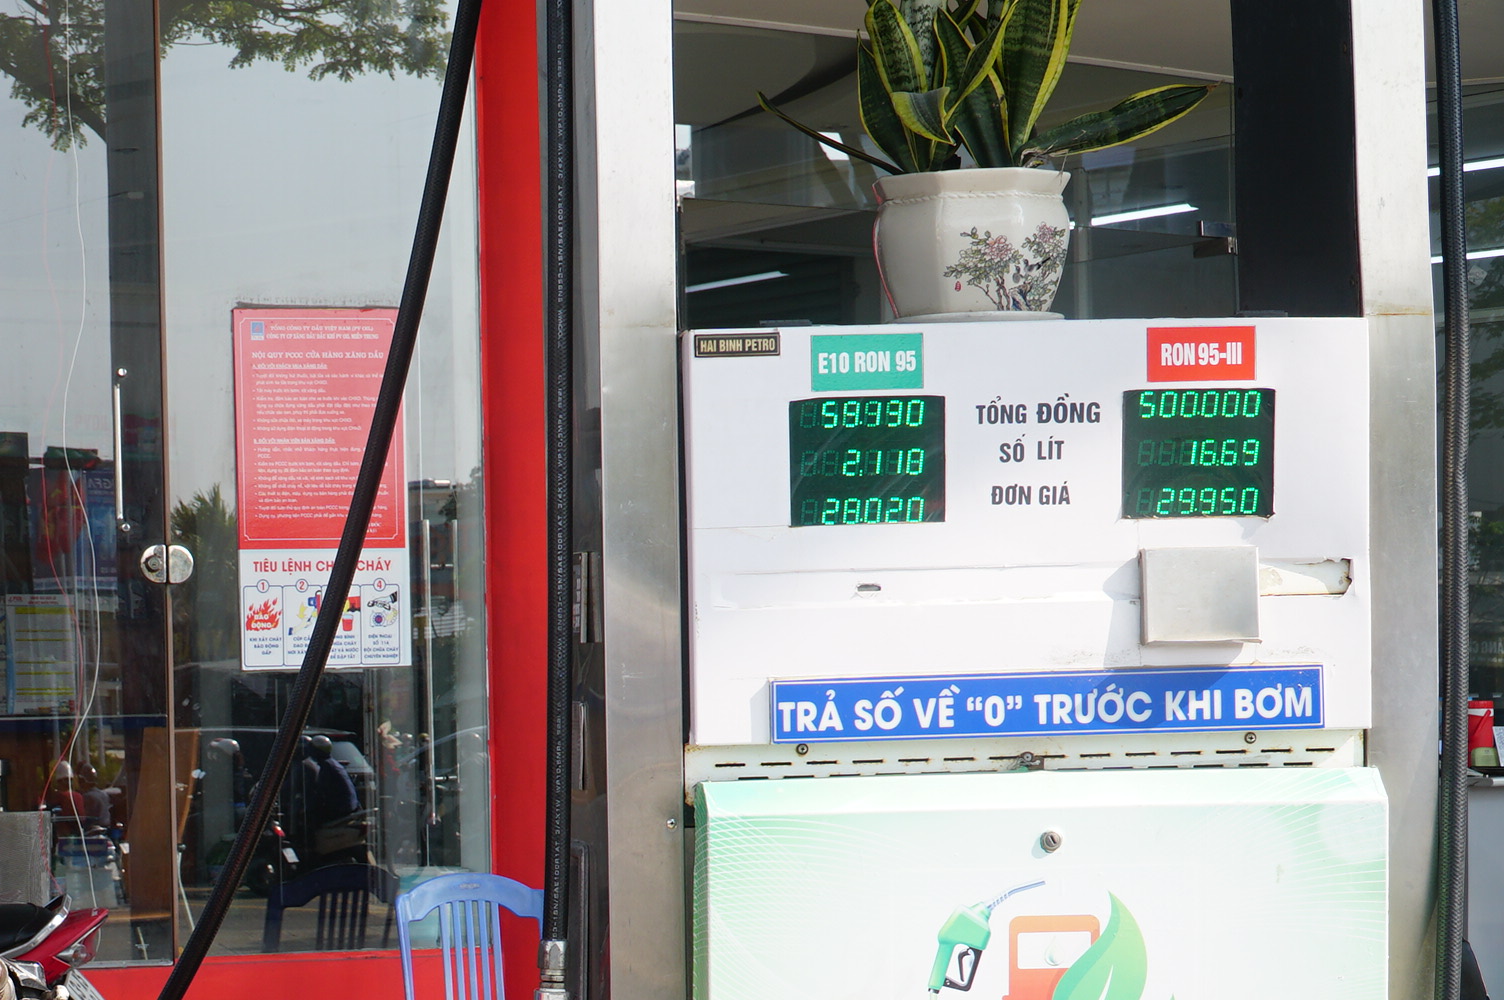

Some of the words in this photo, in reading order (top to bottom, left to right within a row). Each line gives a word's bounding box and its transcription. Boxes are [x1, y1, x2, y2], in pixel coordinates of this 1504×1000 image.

[252, 351, 265, 359] NỘI
[267, 351, 283, 359] QUY
[285, 351, 304, 359] PCCC
[306, 351, 321, 359] CỬA
[322, 351, 343, 359] HÀNG
[345, 351, 367, 359] XĂNG
[368, 351, 383, 359] DẦU
[700, 339, 718, 353] HAI
[720, 339, 743, 353] BINH
[745, 338, 776, 353] PETRO
[1161, 345, 1195, 367] RON
[1198, 343, 1242, 366] 95-III
[818, 352, 849, 375] E10
[854, 352, 891, 373] RON
[895, 351, 917, 371] 95
[976, 396, 1028, 425] TỔNG
[1036, 393, 1101, 423] ĐỒNG
[999, 433, 1026, 463] SỐ
[1037, 437, 1064, 461] LÍT
[991, 484, 1031, 506] ĐƠN
[1038, 478, 1071, 505] GIÁ
[253, 558, 278, 572] TIÊU
[282, 558, 311, 575] LỆNH
[356, 557, 391, 571] CHÁY
[261, 582, 265, 590] 1
[299, 582, 304, 590] 2
[377, 581, 382, 589] 4
[778, 690, 841, 732] TRẢ
[854, 688, 904, 729] SỐ
[913, 685, 961, 727] VỀ
[1034, 687, 1152, 724] TRƯỚC
[1164, 688, 1222, 721] KHI
[1230, 685, 1313, 718] BƠM
